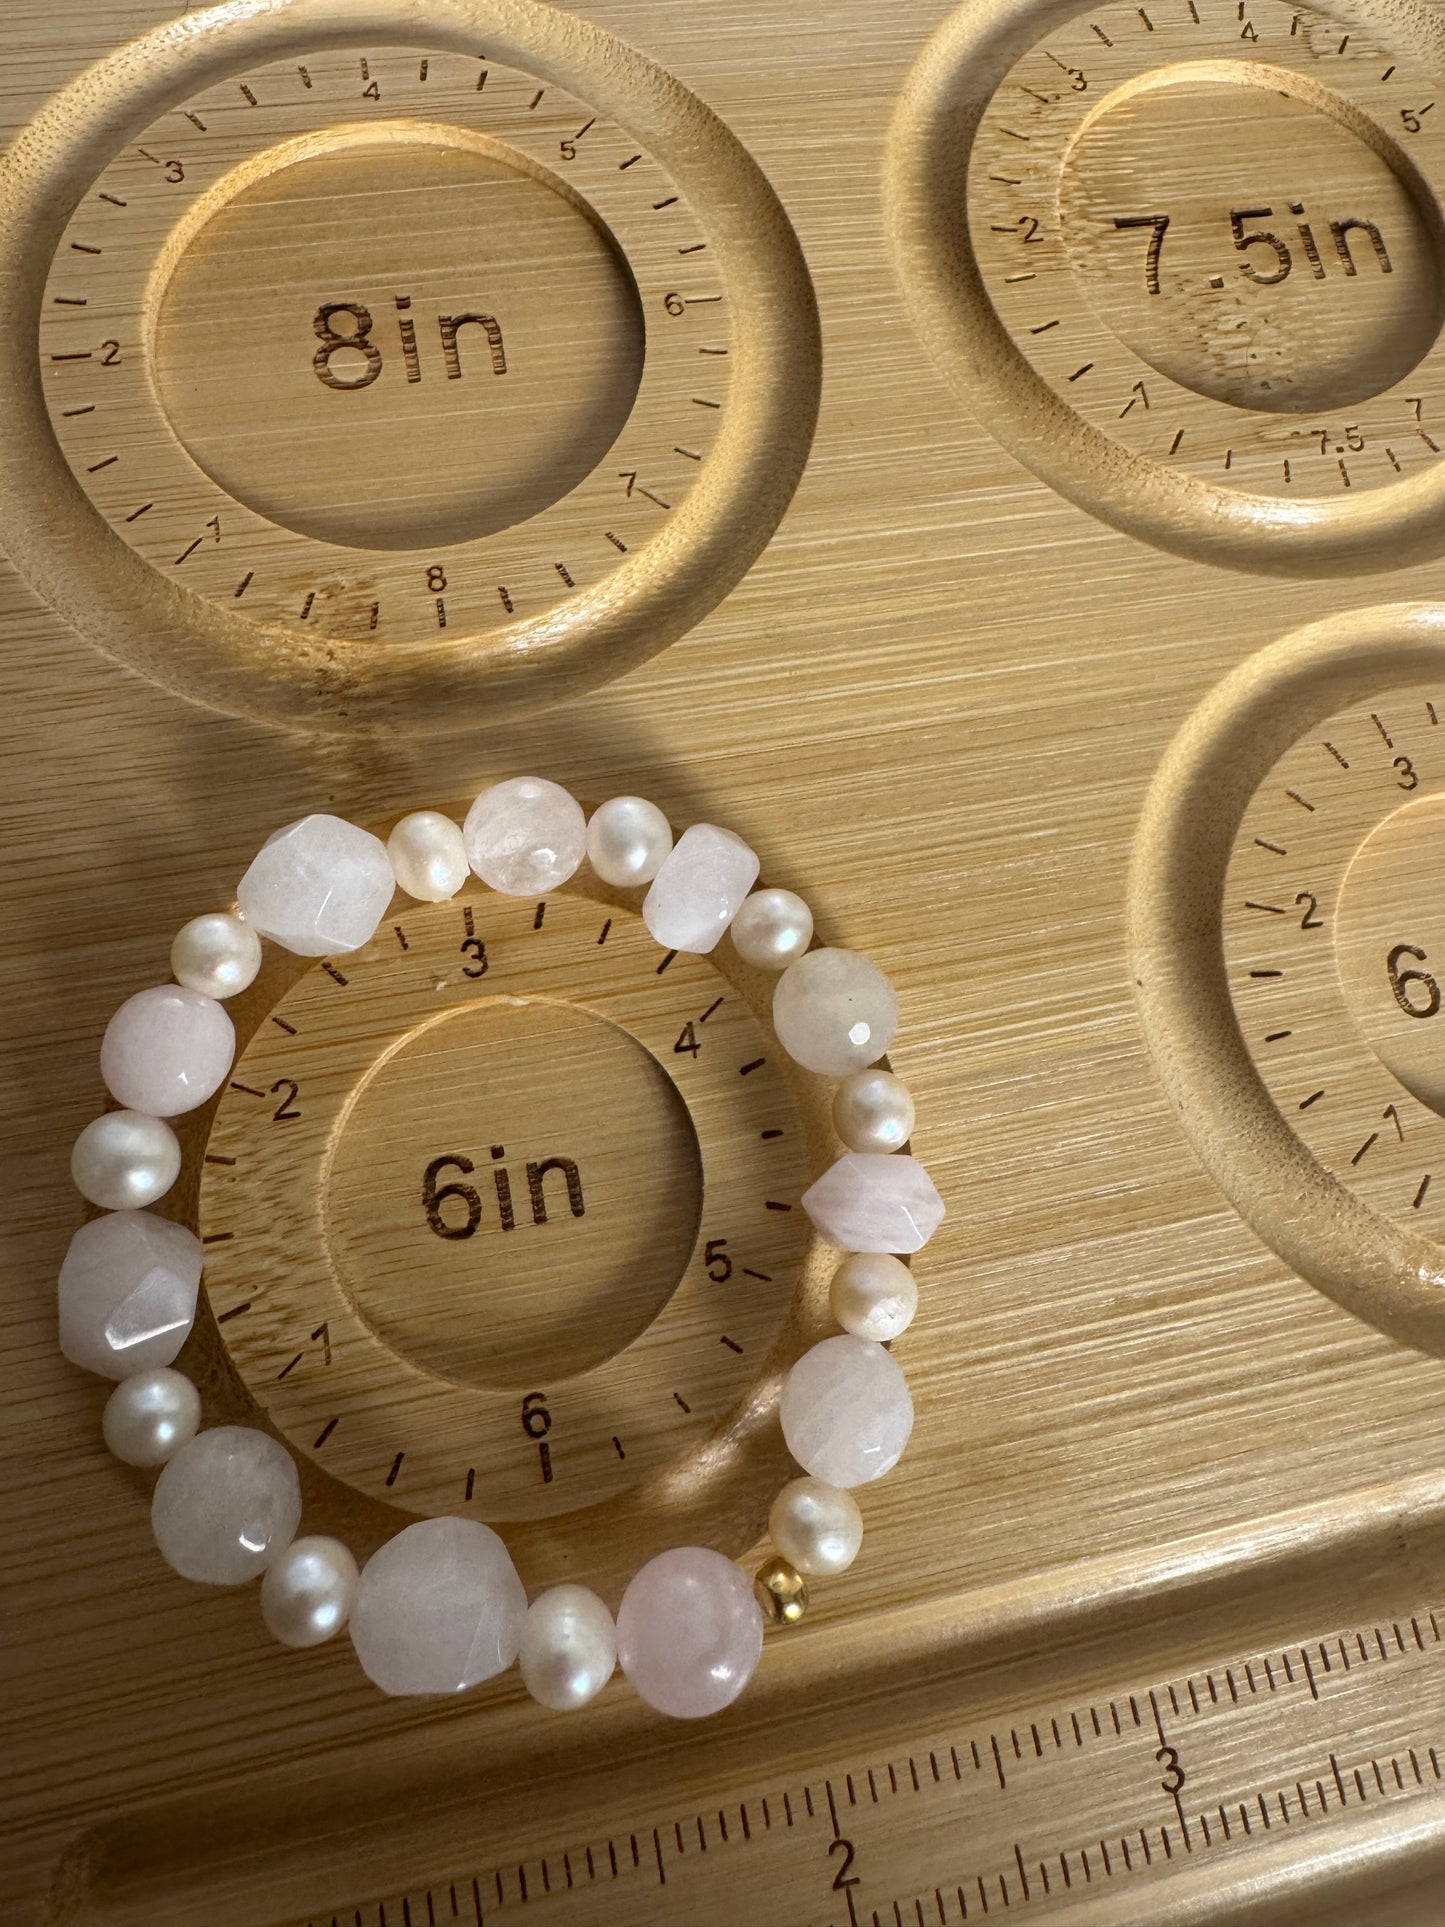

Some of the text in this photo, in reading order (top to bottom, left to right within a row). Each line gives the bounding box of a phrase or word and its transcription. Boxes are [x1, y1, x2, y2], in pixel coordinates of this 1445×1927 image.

[1241, 21, 1258, 42] 4
[363, 80, 380, 100] 4
[1068, 69, 1087, 91] 3
[1401, 109, 1421, 133] 5
[560, 141, 576, 161] 5
[164, 159, 186, 183] 3
[1018, 216, 1044, 243] 2
[664, 292, 685, 315] 6
[100, 340, 122, 366] 2
[312, 295, 507, 390] 8in
[1405, 399, 1422, 422] 7
[1311, 425, 1366, 455] 7.5
[618, 472, 637, 497] 7
[427, 565, 447, 593] 8
[1393, 756, 1418, 790] 3
[1295, 891, 1324, 929] 2
[460, 938, 489, 979] 3
[674, 1021, 700, 1058] 4
[270, 1078, 300, 1121] 2
[1383, 1103, 1404, 1142] 1
[422, 1144, 585, 1241] 6in
[704, 1239, 732, 1282] 5
[311, 1323, 332, 1366] 1
[521, 1392, 552, 1438] 6
[1155, 1745, 1186, 1794] 3
[827, 1839, 861, 1890] 2
